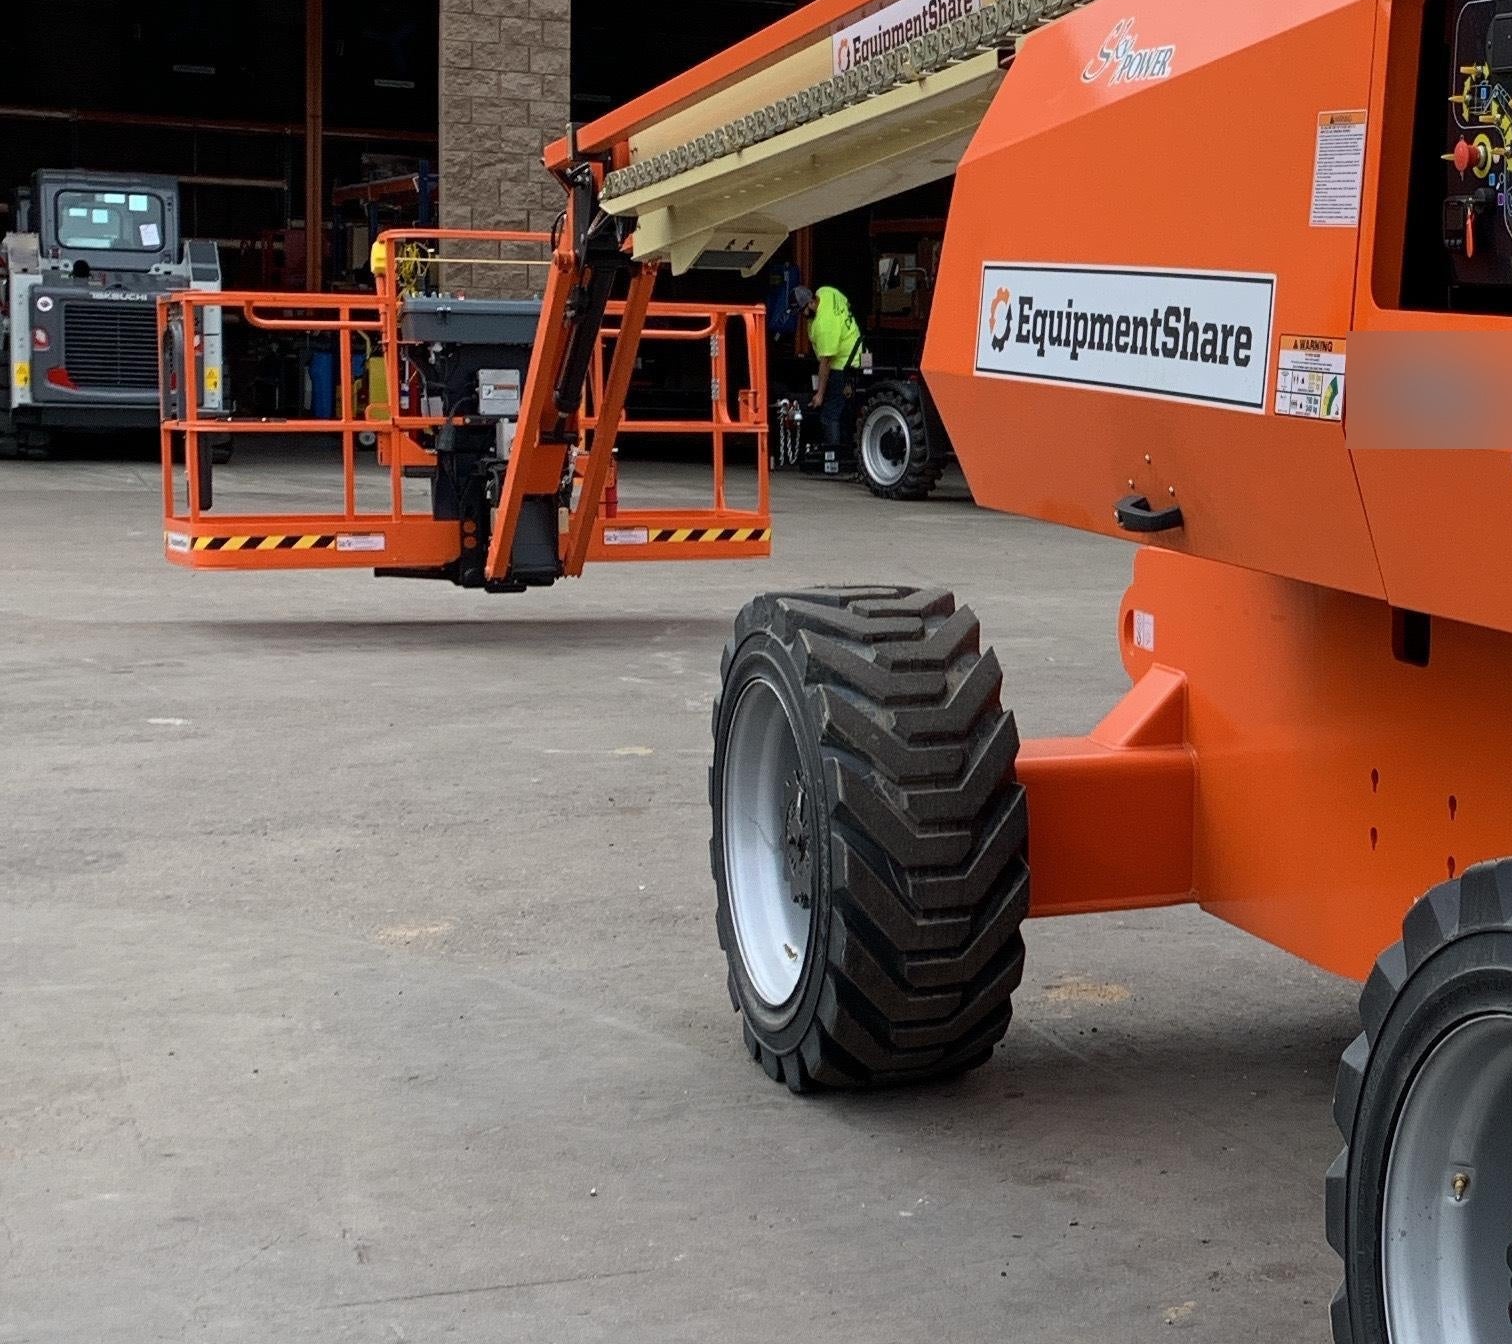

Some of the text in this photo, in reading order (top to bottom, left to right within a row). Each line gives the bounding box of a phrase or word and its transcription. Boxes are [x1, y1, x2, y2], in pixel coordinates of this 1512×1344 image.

[1117, 46, 1174, 83] POWER
[1015, 296, 1253, 368] EquipmentShare
[1299, 339, 1333, 353] WARNING
